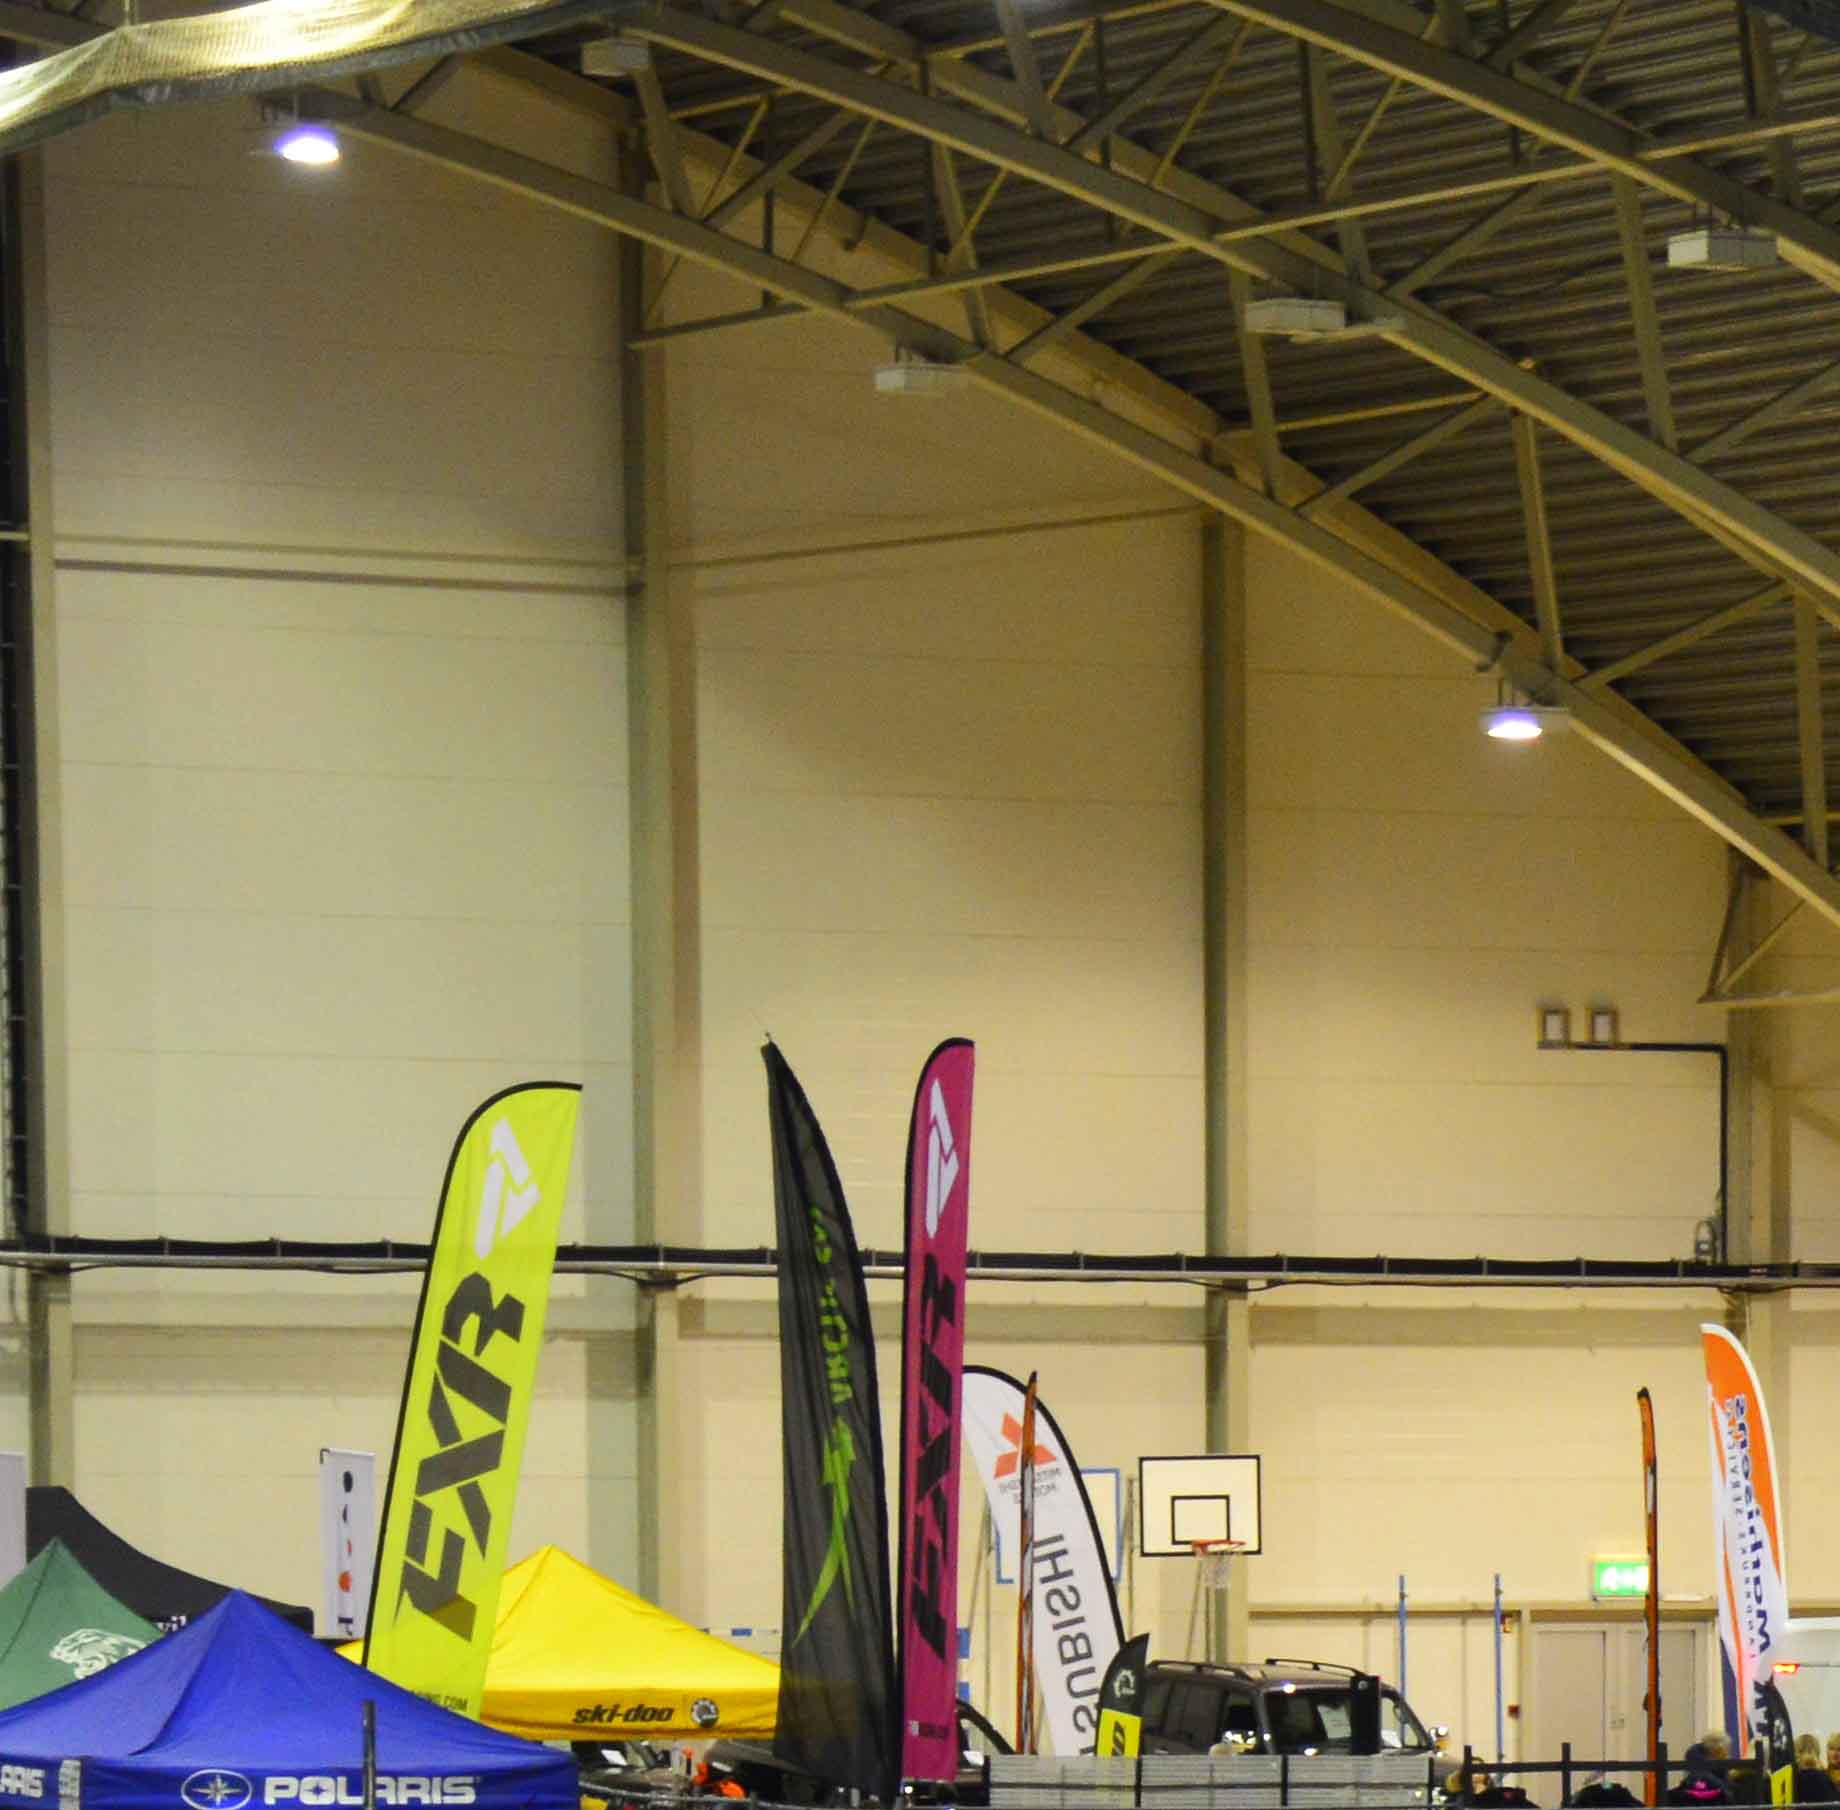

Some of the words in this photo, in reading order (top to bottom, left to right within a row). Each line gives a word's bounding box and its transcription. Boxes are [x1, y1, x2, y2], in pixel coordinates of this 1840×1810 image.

[394, 1271, 525, 1644] FXR
[573, 1703, 675, 1725] ski-doo
[264, 1776, 477, 1805] POLARIS
